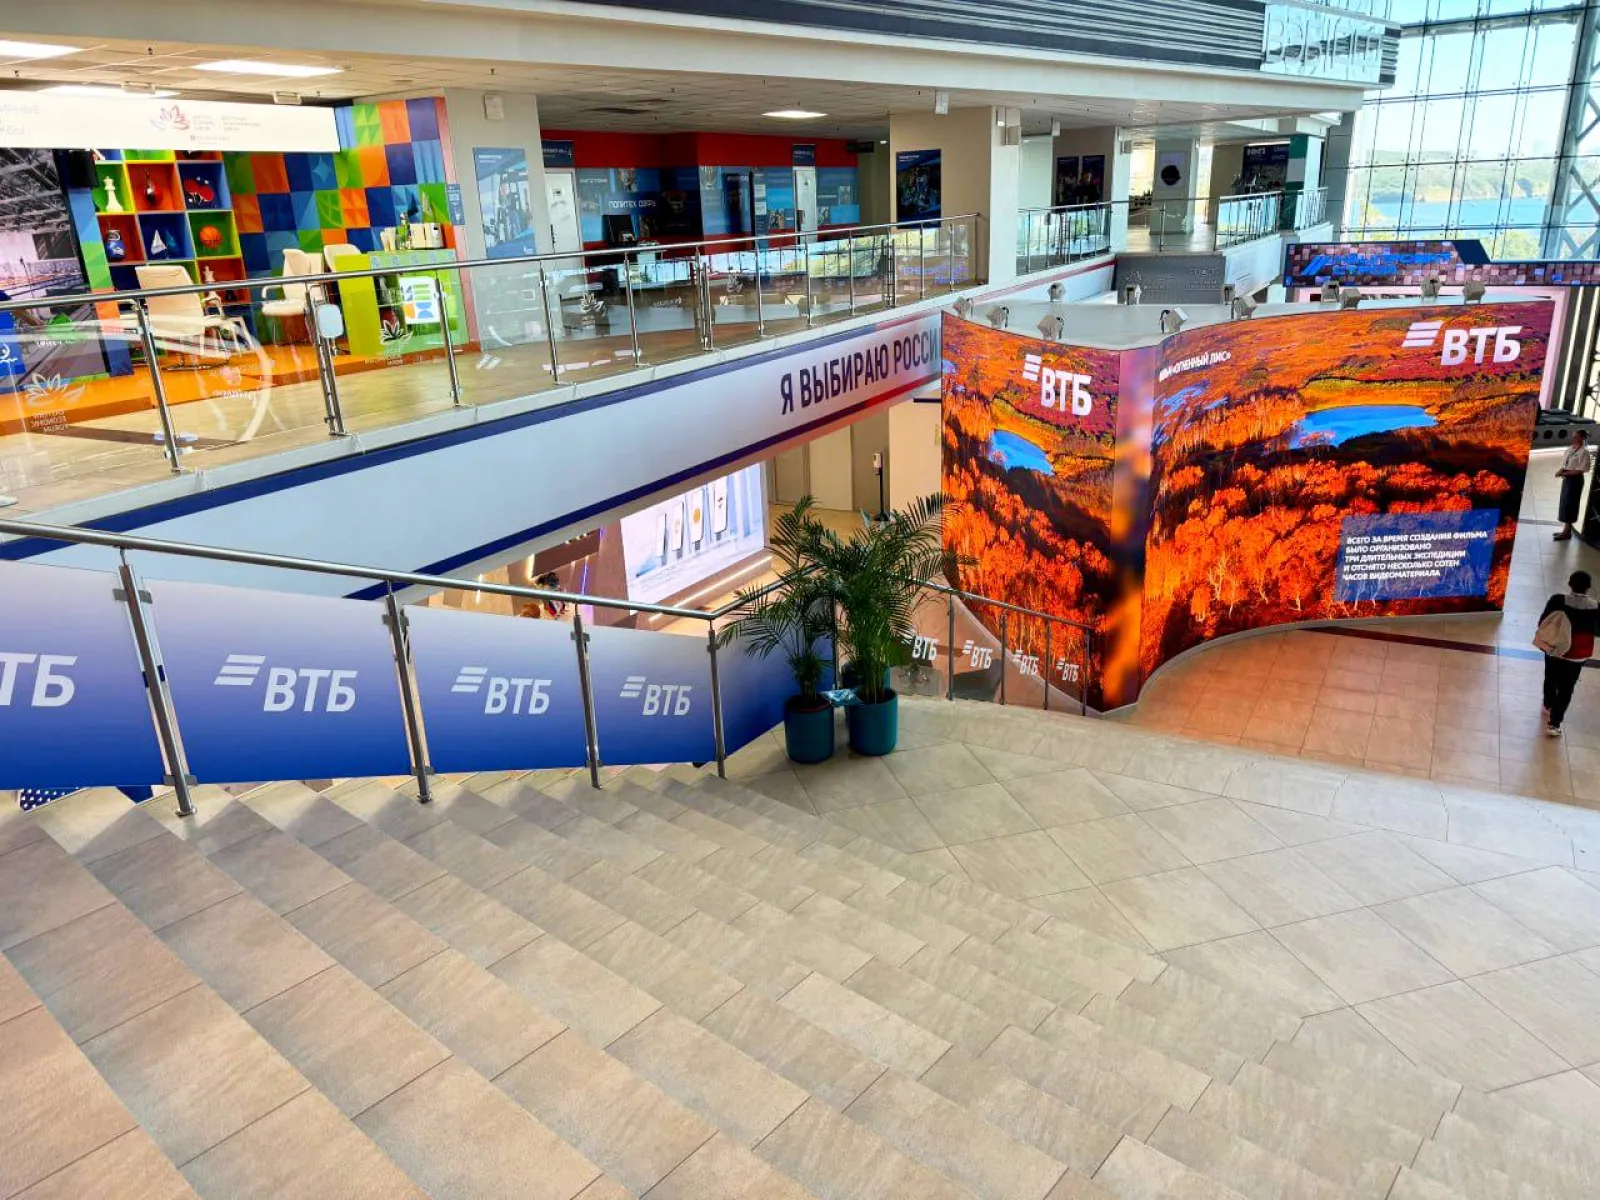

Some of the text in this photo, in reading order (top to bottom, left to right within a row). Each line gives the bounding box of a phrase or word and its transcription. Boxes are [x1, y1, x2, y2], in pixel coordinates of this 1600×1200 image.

[1441, 326, 1522, 366] ВТБ
[780, 327, 941, 415] Я ВЫБИРАЮ РОССИ
[1041, 367, 1092, 416] ВТБ
[1345, 543, 1432, 554] БЫЛО ОРГАНИЗОВАНО
[1383, 534, 1408, 542] ВРЕМЯ
[1409, 533, 1451, 541] СОЗДАНИЯ
[1453, 531, 1488, 539] ФИЛЬМА
[1344, 550, 1466, 563] ТРИ ДЛИТЕЛЬНЫХ ЭКСПЕДИЦИИ
[1351, 563, 1386, 572] ОТСНЯТО
[1387, 561, 1432, 570] НЕСКОЛЬКО
[1434, 560, 1460, 568] СОТЕН
[1342, 570, 1441, 581] ЧАСОВ ВИДЕОМАТЕРИАЛА
[911, 635, 940, 661] ВТБ
[970, 646, 993, 669] ВТБ
[1019, 655, 1040, 676] ВТБ
[1061, 663, 1080, 682] ВТБ
[0, 652, 78, 707] ТБ
[263, 667, 358, 712] ВТБ
[484, 676, 552, 715] ВТБ
[642, 683, 692, 716] ВТБ
